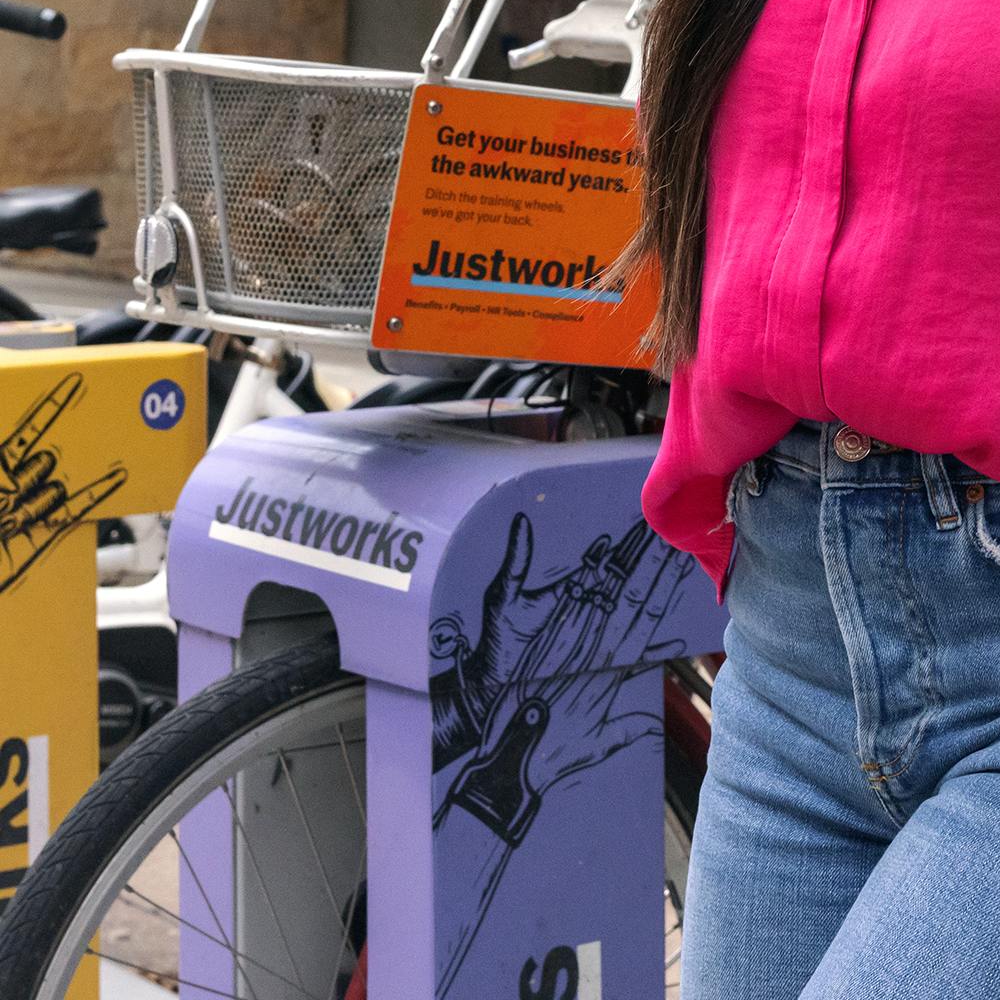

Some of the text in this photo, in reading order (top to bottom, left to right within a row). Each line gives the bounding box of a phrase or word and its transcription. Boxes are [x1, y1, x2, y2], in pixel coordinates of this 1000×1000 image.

[437, 126, 476, 148] Get
[478, 135, 527, 154] your
[530, 136, 622, 165] business
[431, 155, 629, 193] the awkward years.
[425, 187, 457, 201] Ditch
[459, 192, 478, 204] the
[480, 194, 522, 211] training
[455, 211, 475, 223] got
[477, 213, 502, 225] your
[449, 303, 481, 314] Payroll
[503, 308, 526, 317] Tools
[144, 391, 178, 419] 04
[216, 476, 424, 573] Justworks
